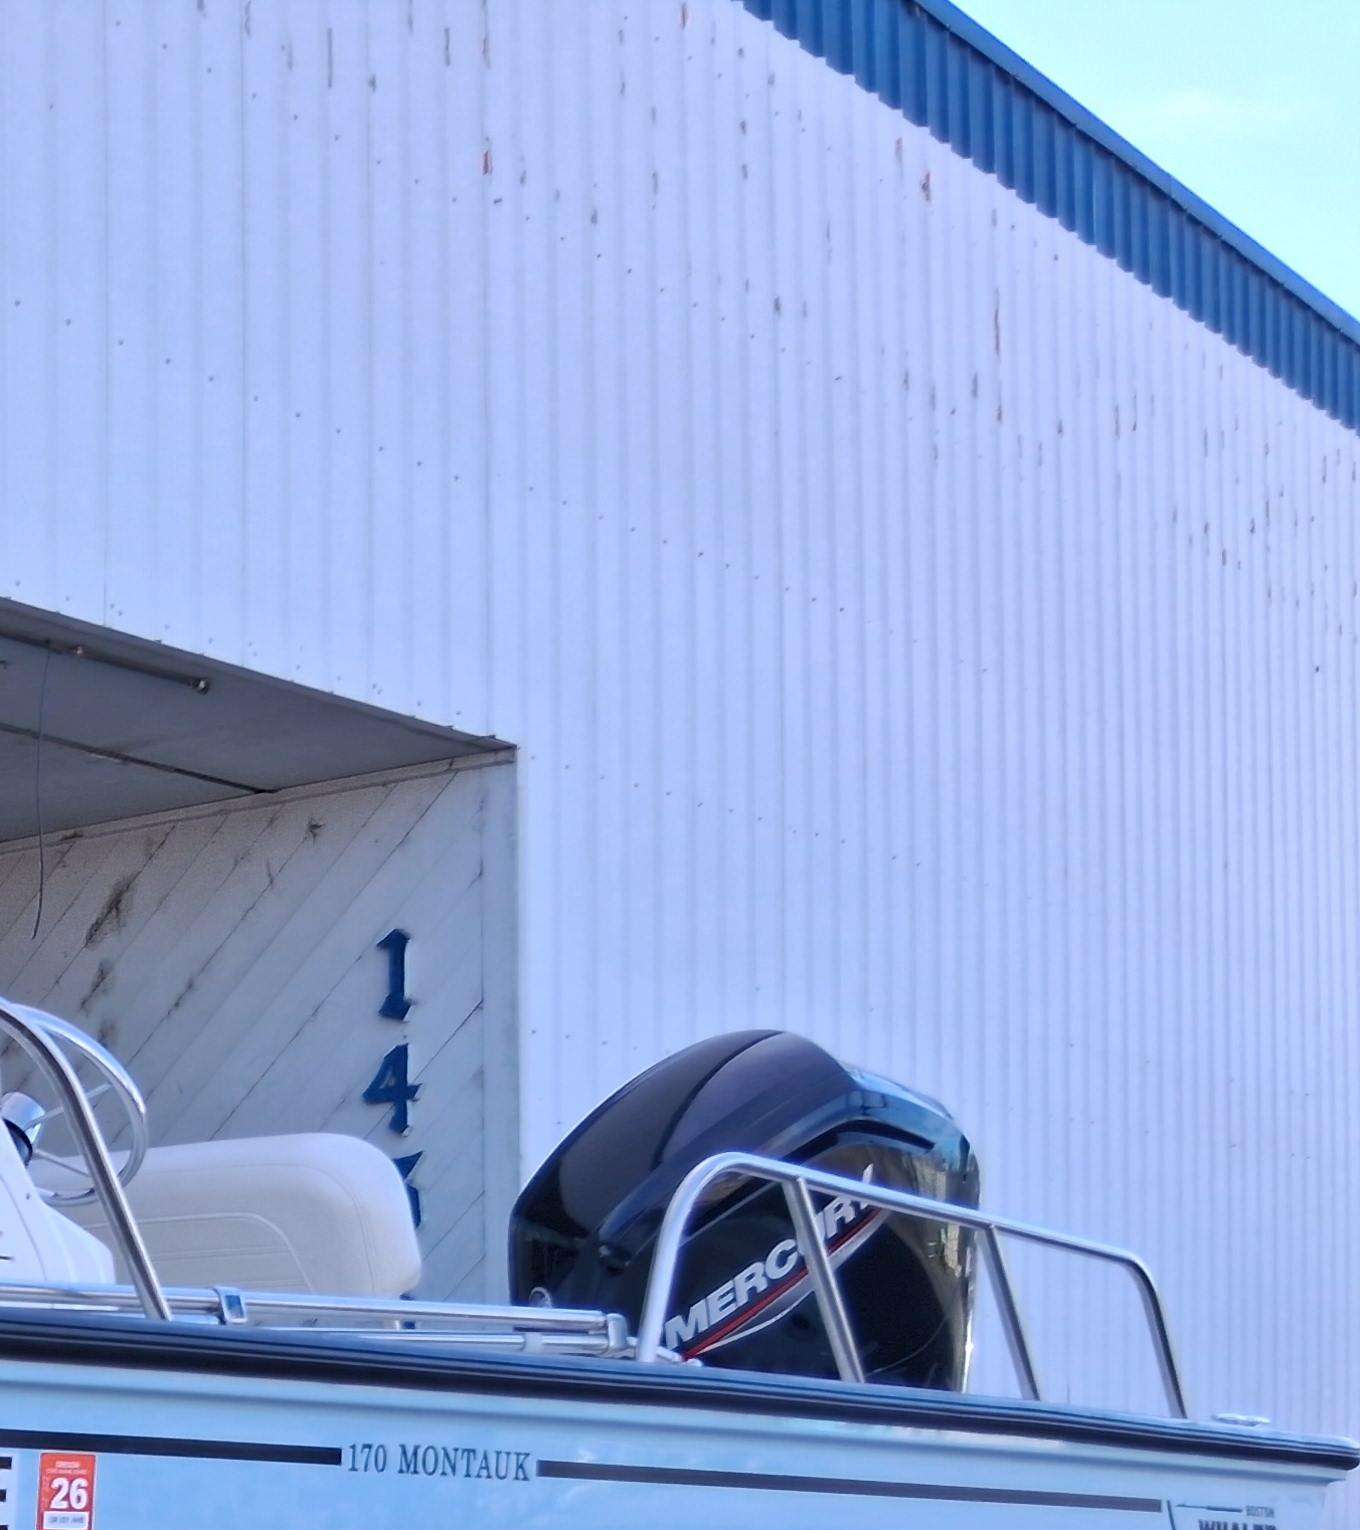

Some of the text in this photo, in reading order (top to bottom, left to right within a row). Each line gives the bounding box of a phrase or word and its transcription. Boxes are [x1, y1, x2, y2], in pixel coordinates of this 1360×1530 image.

[348, 1444, 530, 1482] 170 MONTAUK
[49, 1477, 89, 1510] 26
